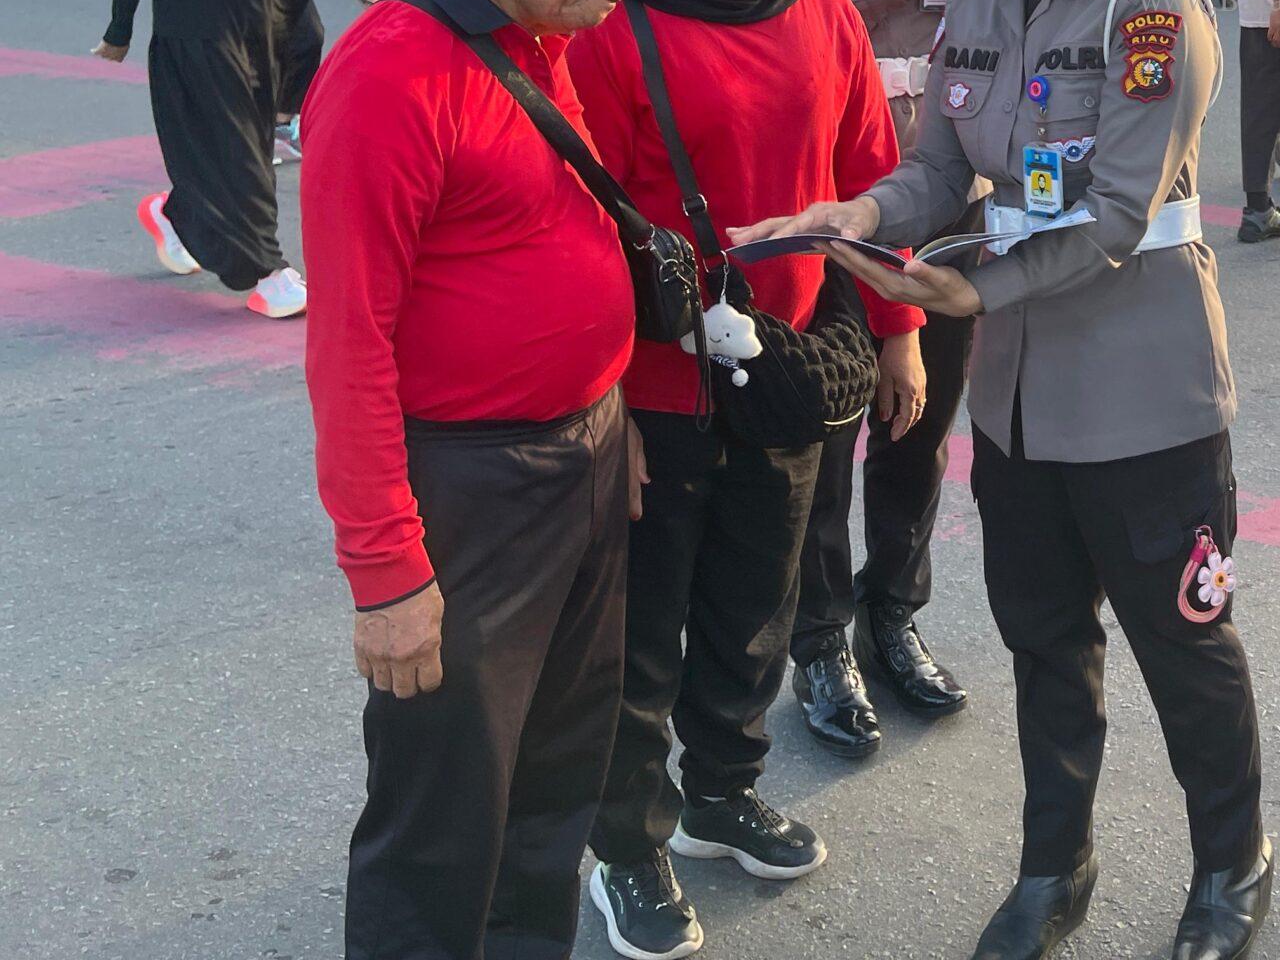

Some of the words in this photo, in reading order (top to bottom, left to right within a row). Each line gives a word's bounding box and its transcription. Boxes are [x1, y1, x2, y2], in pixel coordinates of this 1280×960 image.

[1125, 14, 1175, 34] POLDA
[1131, 35, 1169, 45] RIAU
[945, 46, 1000, 72] RANI
